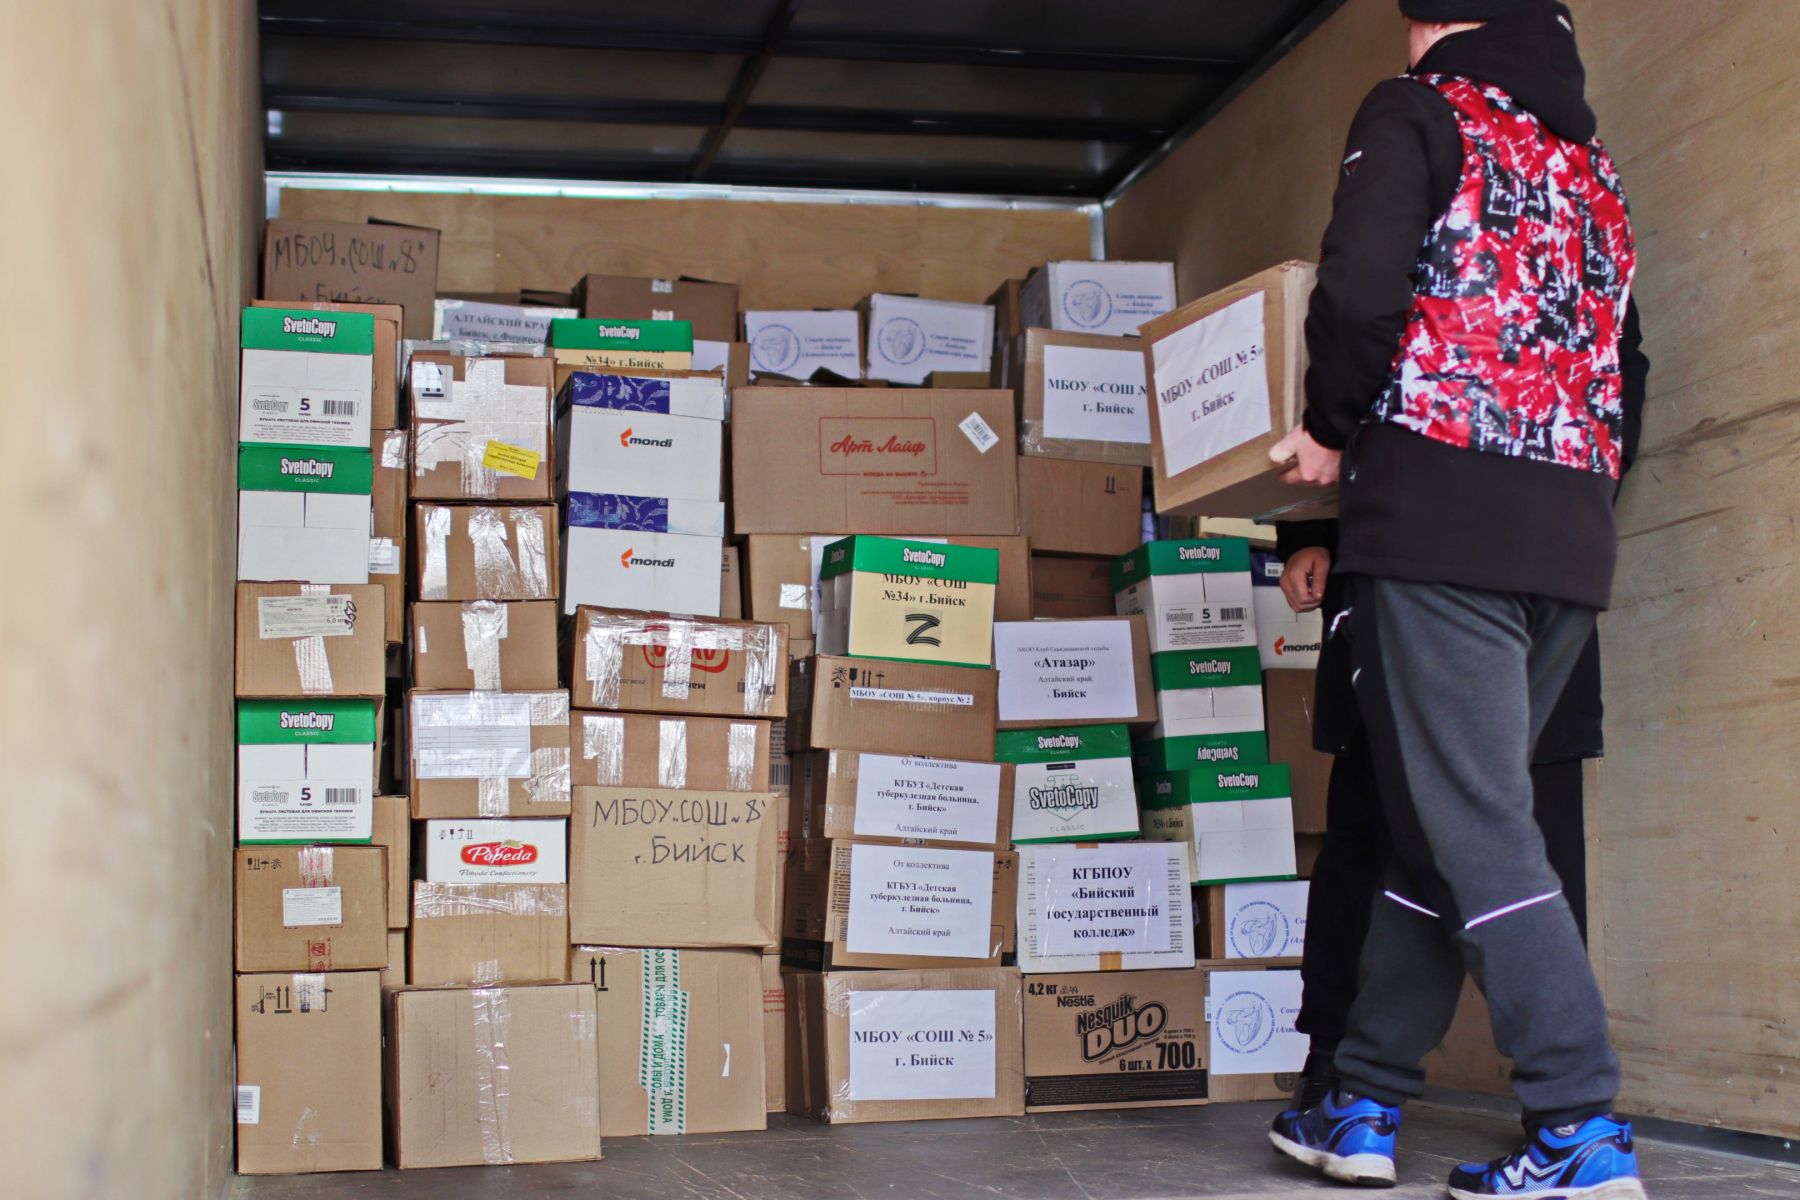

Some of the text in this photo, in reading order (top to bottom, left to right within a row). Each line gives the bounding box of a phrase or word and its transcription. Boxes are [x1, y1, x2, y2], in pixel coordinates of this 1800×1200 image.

[283, 315, 337, 338] SvetoCopy
[454, 314, 522, 328] АЛТАЙСКИЙ
[600, 325, 640, 339] SvetoCopy
[1048, 378, 1090, 393] МБОУ
[1093, 382, 1134, 395] «СОШ
[1160, 376, 1193, 407] МБОУ
[1196, 357, 1233, 386] «СОШ
[300, 398, 310, 412] 5
[1082, 402, 1135, 414] г. Бийск
[1202, 391, 1236, 416] Бийск
[630, 436, 673, 448] mondi
[831, 435, 926, 456] Арт Лайф
[281, 458, 334, 479] SvetoCopy
[903, 548, 946, 568] SvetoCopy
[1179, 546, 1220, 561] SvetoCopy
[630, 557, 676, 568] mondi
[882, 574, 922, 586] МБОУ
[882, 589, 966, 608] №34» г.Бийск
[1202, 608, 1210, 619] 5
[905, 613, 942, 648] Z
[1282, 641, 1320, 652] mondi
[1034, 657, 1096, 670] «Атазар»
[1190, 660, 1231, 674] SvetoCopy
[851, 688, 877, 698] МБОУ
[879, 690, 904, 699] «СОШ
[928, 696, 954, 704] корпус
[1053, 689, 1087, 699] Бийск
[281, 711, 334, 731] SvetoCopy
[1038, 734, 1080, 749] SvetoCopy
[1197, 746, 1239, 761] SvetoCopy
[902, 758, 958, 770] От коллектива
[894, 779, 964, 792] КГБУЗ «Детская
[1218, 772, 1259, 788] SvetoCopy
[300, 787, 312, 801] 5
[877, 790, 937, 801] туберкулезная
[1029, 785, 1098, 810] SvetoCopy
[594, 799, 673, 828] МБОУ
[916, 803, 947, 812] Бийск»
[896, 823, 958, 836] Алтайский край
[1050, 823, 1086, 833] CLASSIC
[467, 844, 533, 864] Pobeda
[652, 836, 746, 864] Бийск
[894, 859, 950, 870] От коллектива
[1072, 866, 1133, 880] КГБПОУ
[887, 881, 957, 893] КГБУЗ «Детская
[1072, 886, 1135, 900] «Бийский
[870, 892, 973, 906] туберкулезная больница,
[910, 904, 940, 914] Бийск»
[1048, 904, 1159, 922] государственный
[888, 926, 951, 938] Алтайский край
[1073, 928, 1136, 939] колледж»
[656, 966, 668, 982] ДЛЯ
[1028, 983, 1044, 996] 4,2
[655, 985, 665, 1018] ТОВАРЫ
[1078, 994, 1134, 1034] Nesquik
[854, 1030, 993, 1044] МБОУ «СОШ № 5»
[1082, 1001, 1168, 1062] DUO
[654, 1034, 664, 1060] ДОМА
[896, 1054, 955, 1068] г. Бийск
[1120, 1058, 1126, 1071] 6
[1156, 1041, 1196, 1070] 700
[662, 1098, 674, 1124] ДОМА
